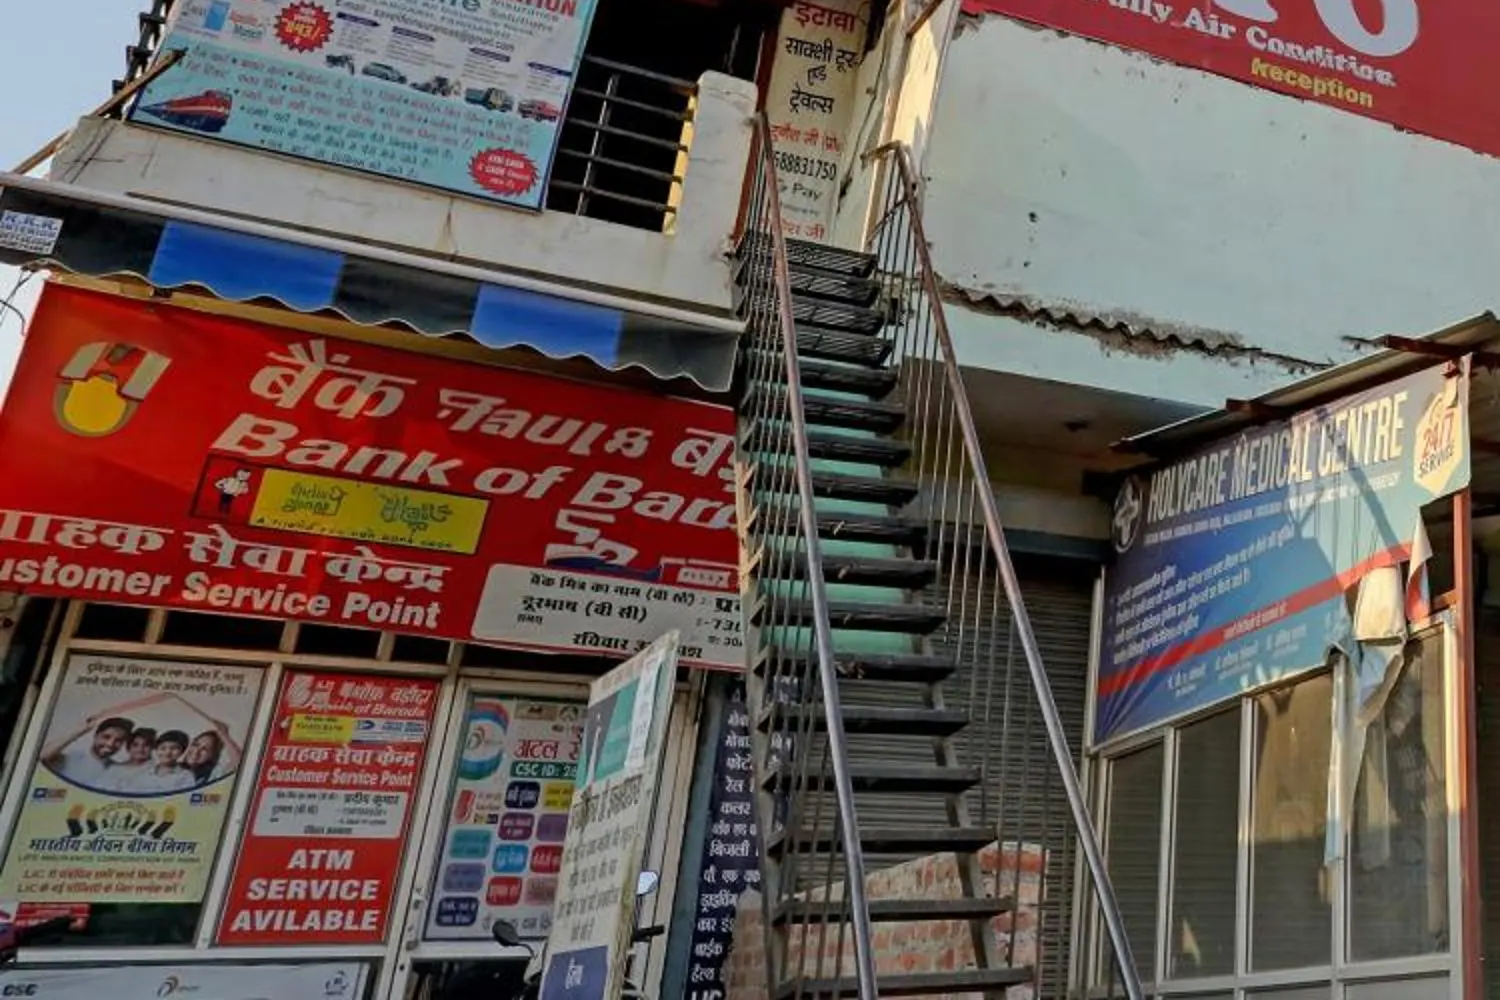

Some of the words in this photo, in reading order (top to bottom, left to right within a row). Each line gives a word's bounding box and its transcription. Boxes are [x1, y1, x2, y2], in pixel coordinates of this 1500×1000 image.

[795, 2, 856, 34] इटावा
[1183, 8, 1238, 40] Air
[250, 338, 418, 419] बैंक
[209, 411, 464, 488] Bank
[474, 464, 575, 499] of
[1147, 449, 1227, 522] HOLYCARE
[1229, 418, 1314, 501] MEDICAL
[1317, 392, 1408, 478] CENTRE
[183, 523, 318, 578] सेवा
[321, 545, 452, 594] केन्द्र
[182, 568, 332, 616] Service
[341, 591, 442, 629] Point
[267, 766, 328, 785] Customer
[332, 768, 378, 786] Service
[381, 771, 413, 787] Point
[515, 763, 541, 777] CSC
[29, 837, 83, 854] भारतीय
[85, 834, 123, 854] जीवन
[126, 836, 158, 855] बीमा
[161, 837, 198, 856] निगम
[709, 839, 750, 858] बिजली
[288, 849, 354, 870] ATM
[246, 878, 381, 901] SERVICE
[229, 909, 381, 932] AVILABLE
